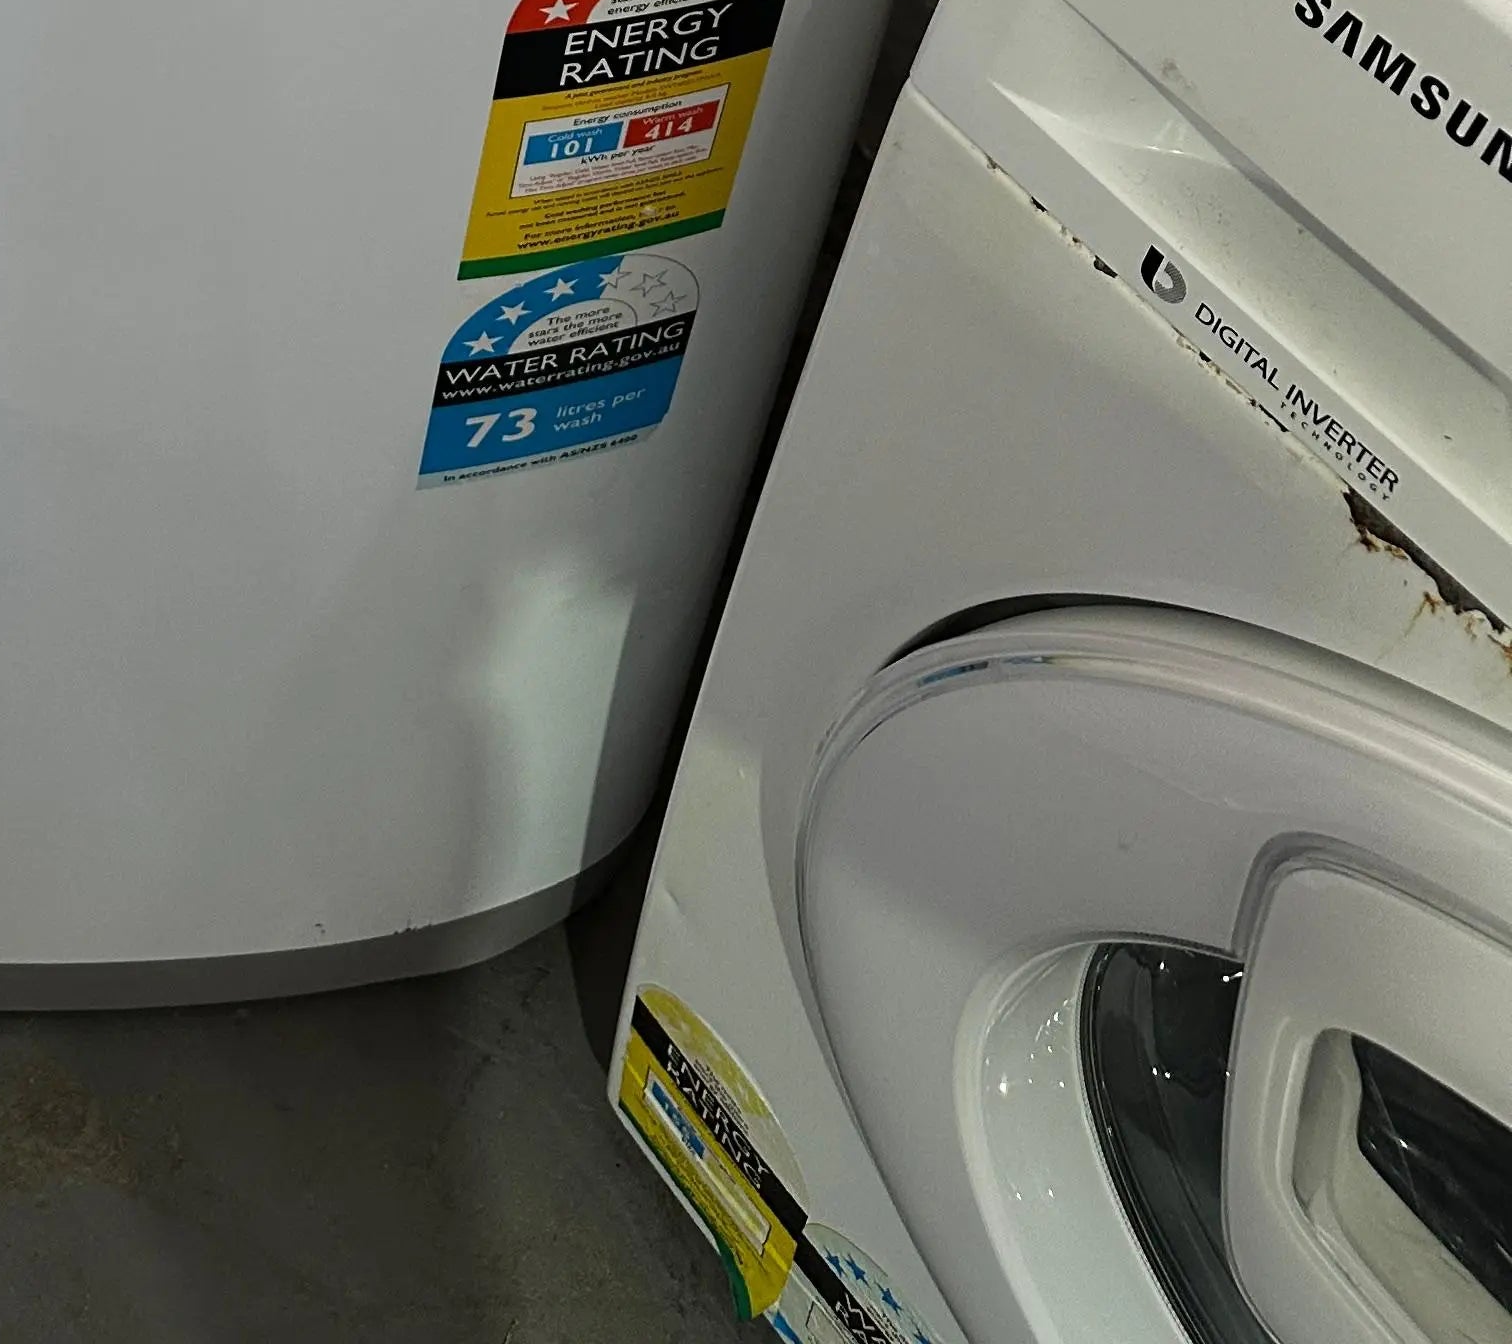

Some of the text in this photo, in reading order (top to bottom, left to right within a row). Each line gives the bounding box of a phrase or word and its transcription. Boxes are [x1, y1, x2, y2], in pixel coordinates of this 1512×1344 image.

[607, 1, 650, 16] energy
[564, 3, 733, 56] ENERGY
[559, 36, 720, 86] RATING
[573, 116, 609, 127] Energy
[613, 99, 683, 121] consumption
[645, 122, 694, 140] 414
[548, 132, 574, 142] Cold
[550, 138, 593, 158] 101
[547, 316, 572, 326] The
[445, 321, 685, 385] WATER RATING
[1194, 302, 1399, 492] DIGITAL INVERTER
[465, 389, 645, 448] 73 litres per
[553, 413, 602, 433] wash
[1281, 401, 1389, 501] TECHNOLOGY
[667, 1044, 769, 1175] ENERGY
